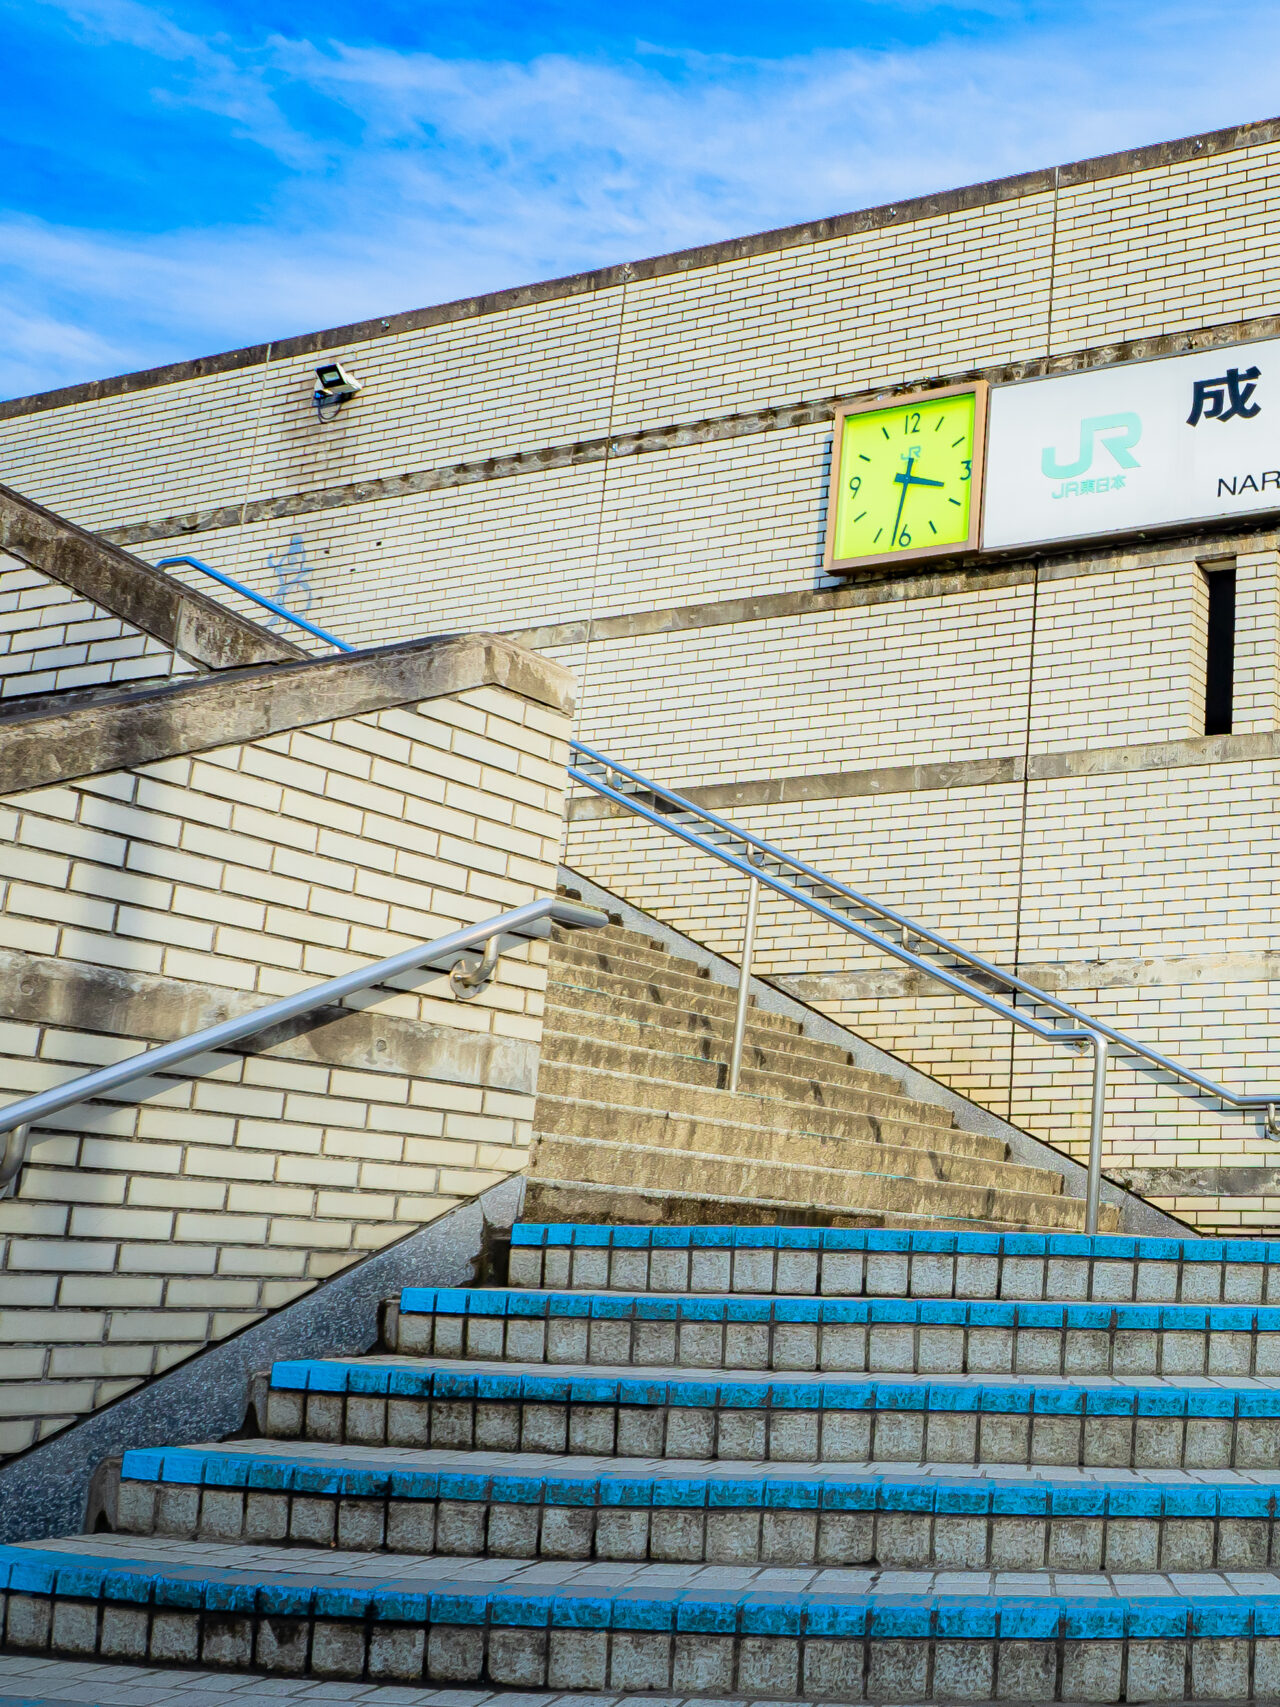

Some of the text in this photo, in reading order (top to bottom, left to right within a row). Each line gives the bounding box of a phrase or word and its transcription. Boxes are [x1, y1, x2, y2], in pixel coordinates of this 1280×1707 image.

[904, 412, 921, 435] 12
[900, 445, 921, 461] JR
[1041, 411, 1143, 479] JR
[959, 459, 972, 481] 3
[849, 476, 862, 499] 9
[1051, 475, 1127, 499] JR東日本
[898, 523, 912, 547] 6
